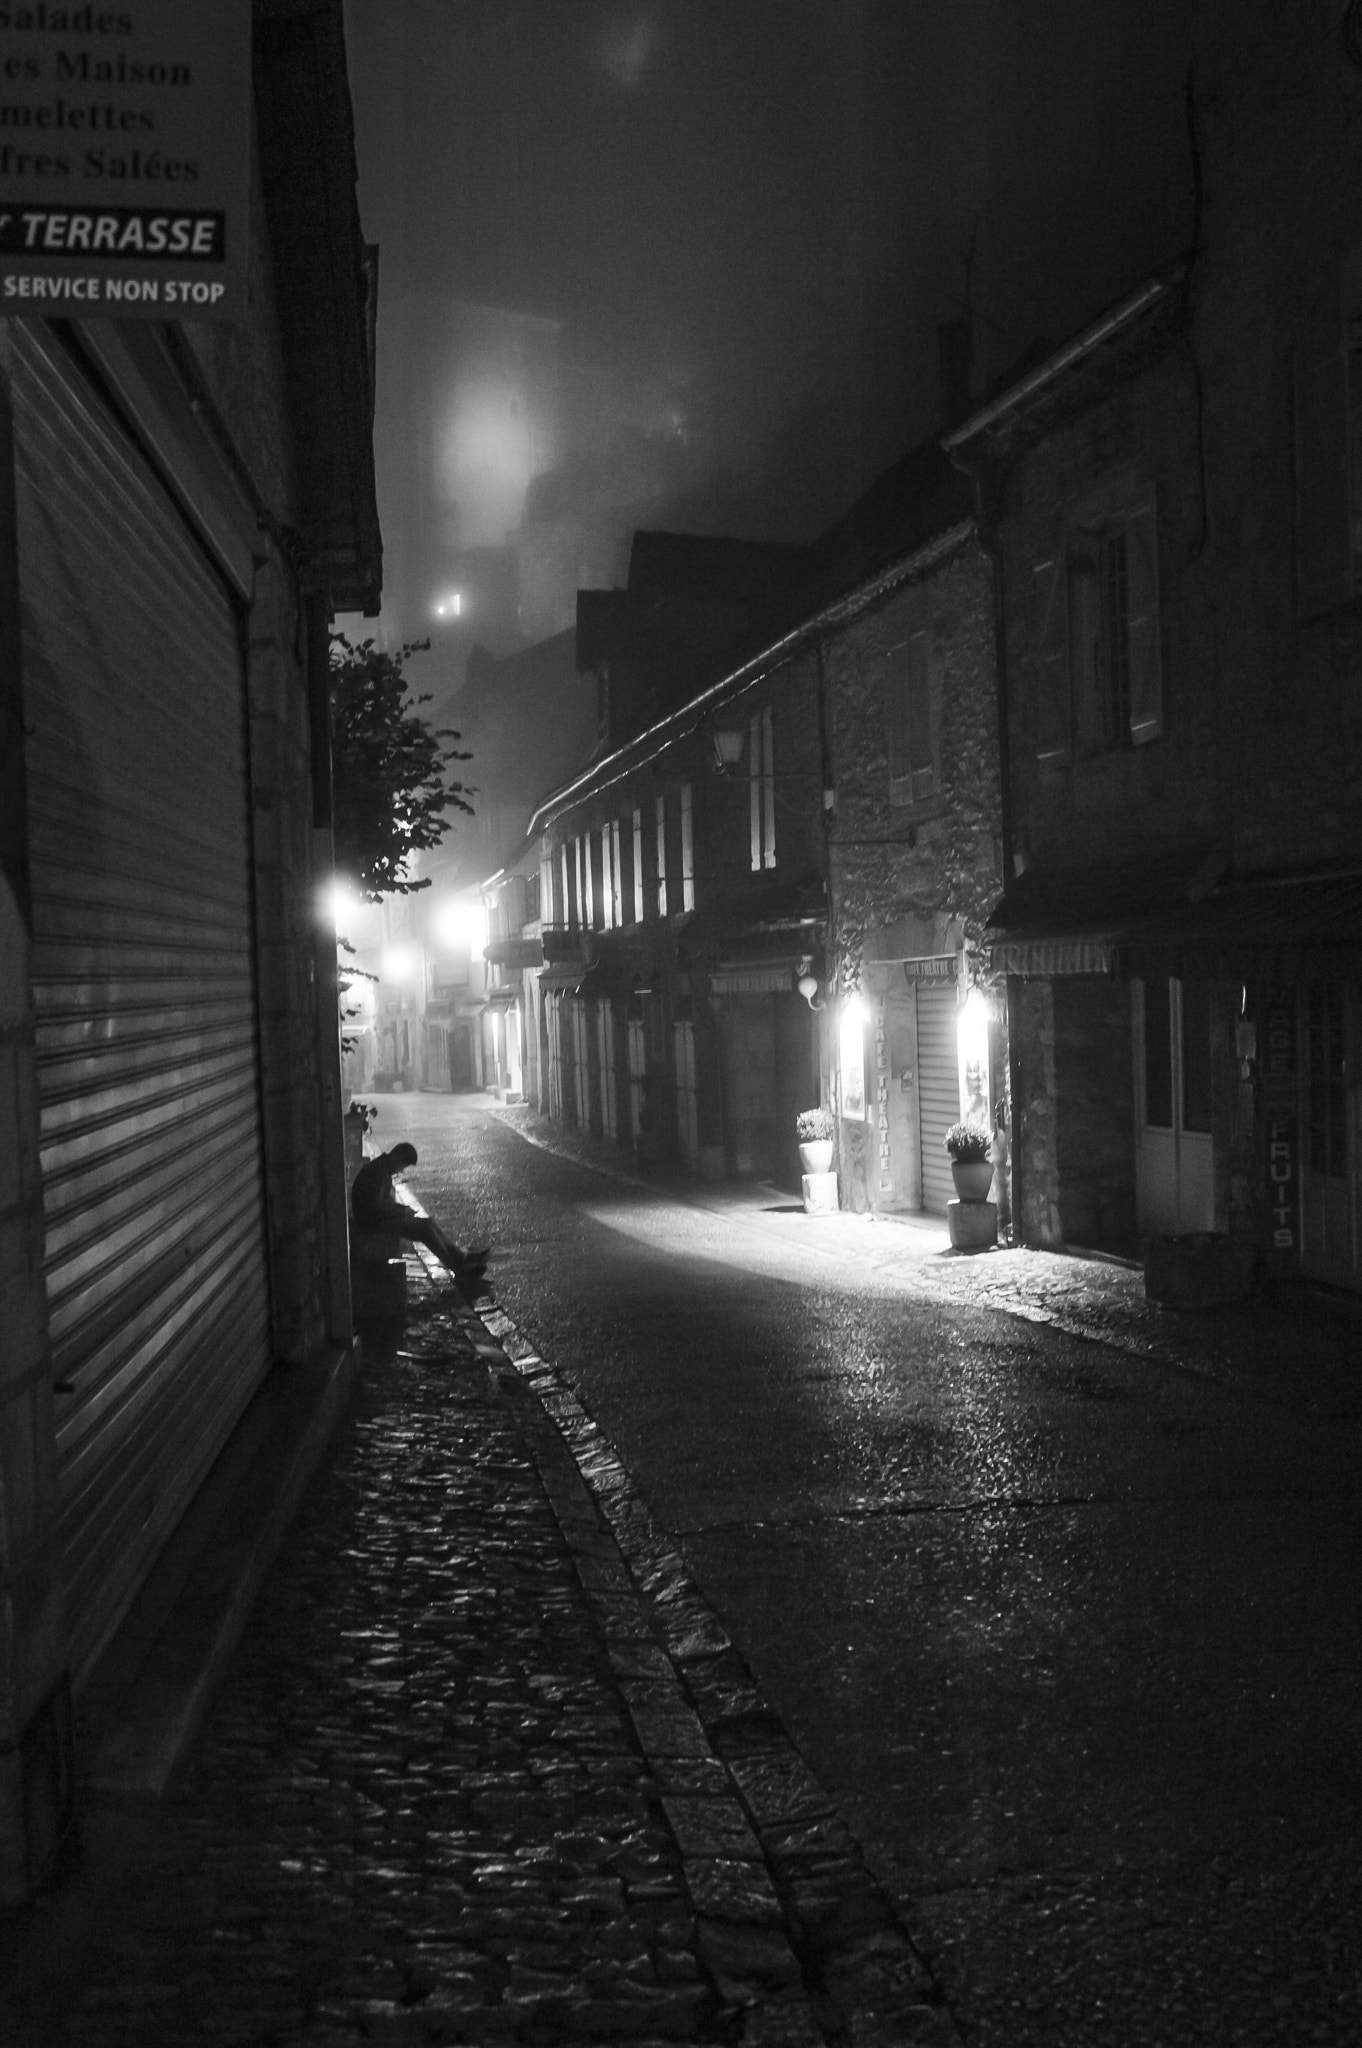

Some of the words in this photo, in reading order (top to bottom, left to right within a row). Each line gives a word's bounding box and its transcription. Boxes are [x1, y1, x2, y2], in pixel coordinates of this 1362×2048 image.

[56, 51, 192, 86] Maison
[84, 147, 201, 182] Salées
[22, 213, 217, 253] TERRASSE
[4, 275, 101, 301] SERVICE
[106, 279, 159, 302] NON
[165, 281, 226, 305] STOP
